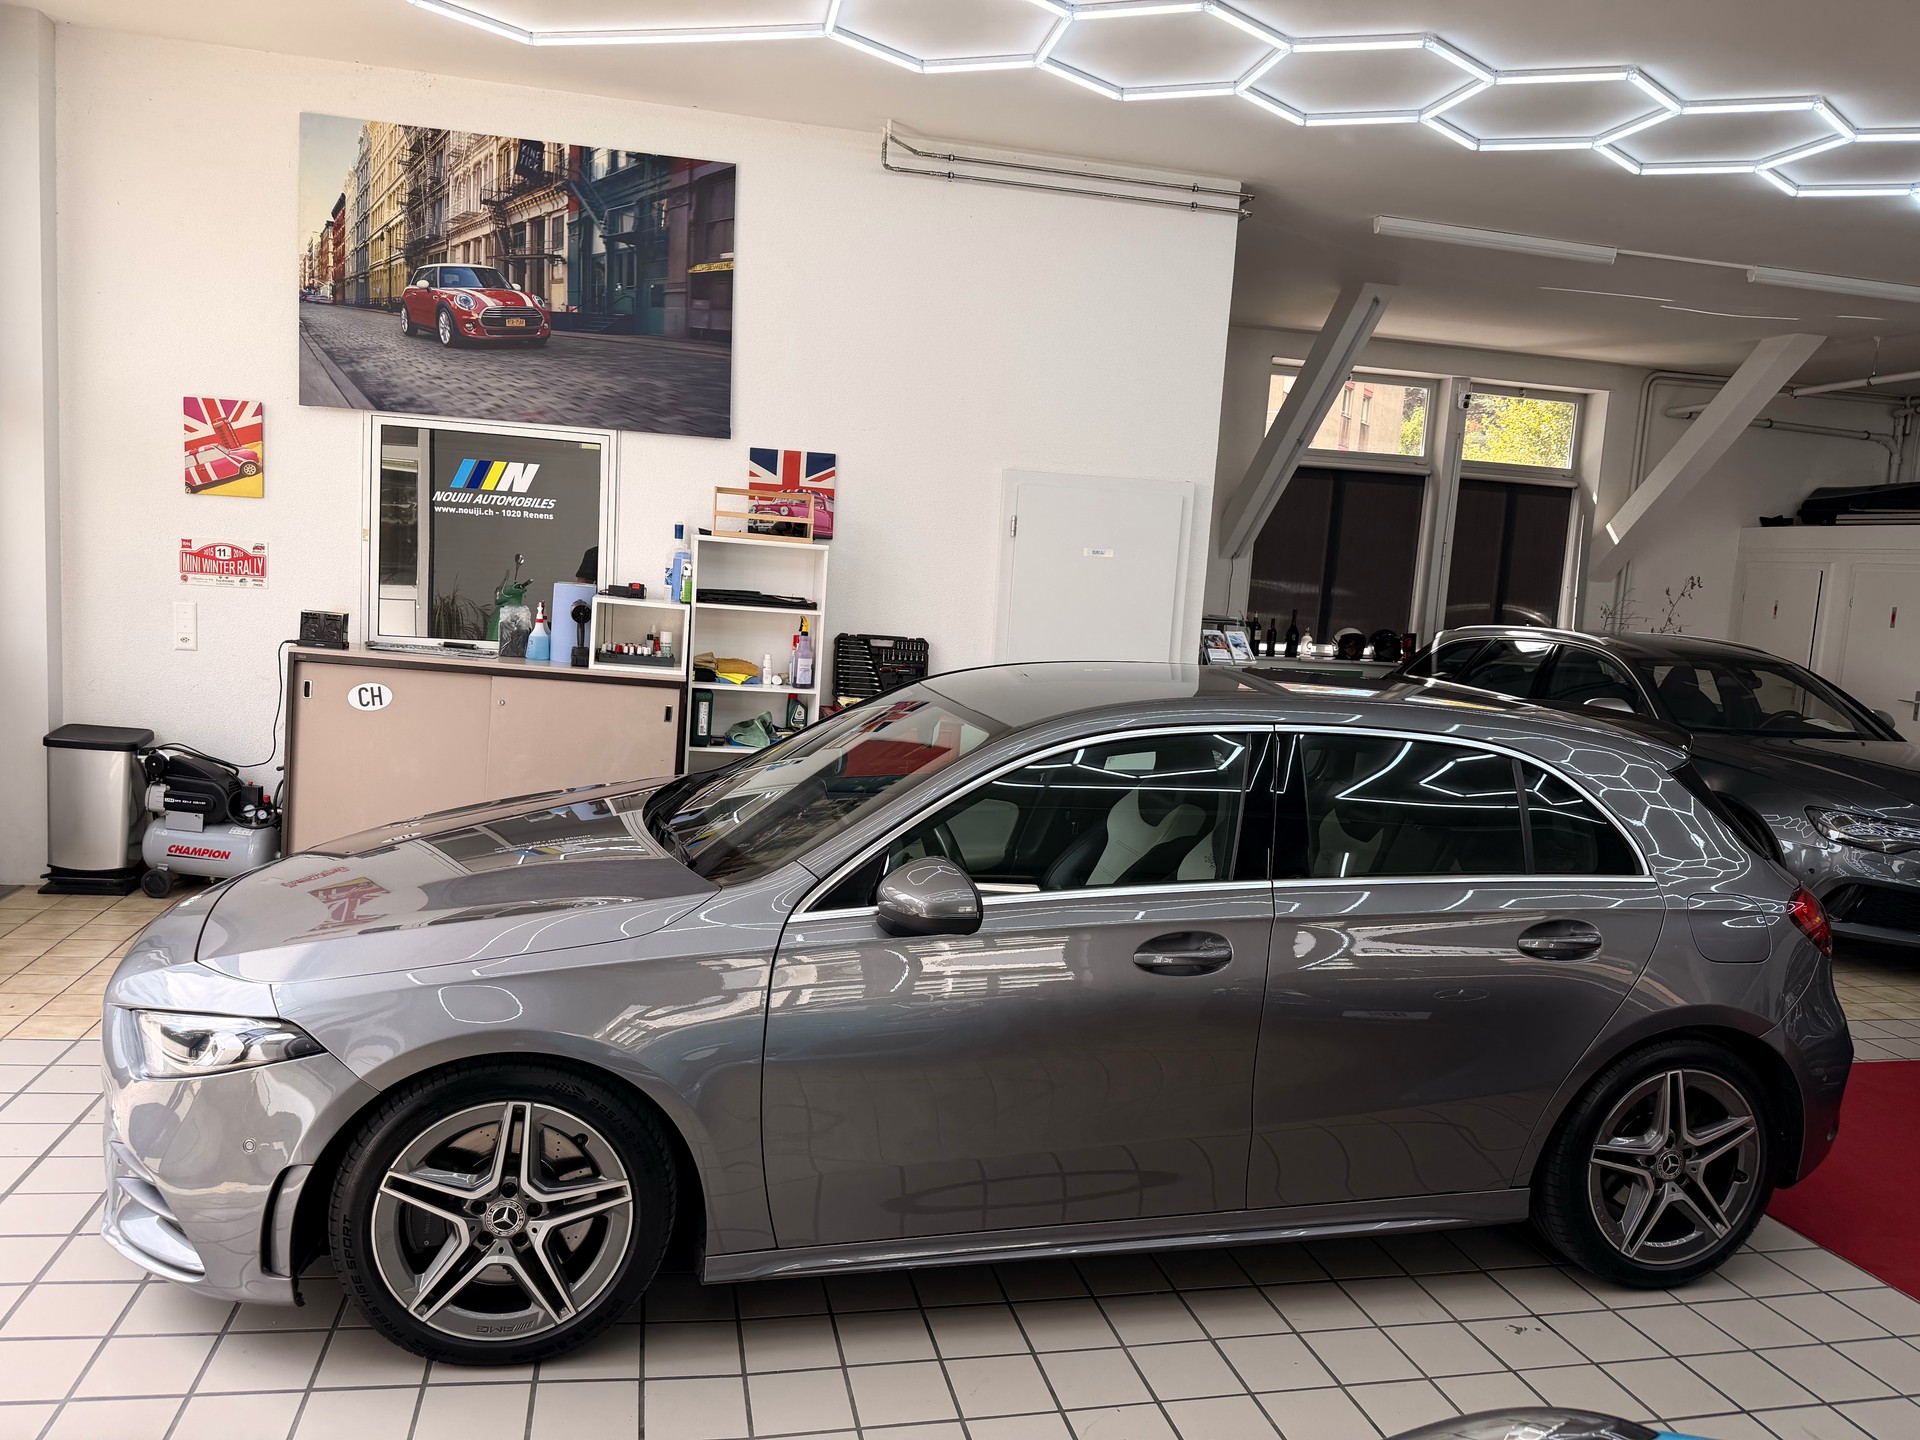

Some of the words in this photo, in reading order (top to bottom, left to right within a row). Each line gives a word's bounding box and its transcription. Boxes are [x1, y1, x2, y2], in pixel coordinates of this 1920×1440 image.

[432, 491, 474, 504] NOUIJI
[473, 494, 556, 509] AUTOMOBILES
[434, 506, 494, 516] www.nouiji.ch
[501, 509, 521, 518] 1020
[523, 511, 554, 520] Renens
[217, 548, 226, 557] 11
[182, 552, 201, 572] MINI
[202, 557, 236, 574] WINTER
[237, 557, 264, 576] RALLY
[358, 686, 383, 707] CH
[167, 844, 231, 860] CHAMPION
[342, 1215, 357, 1270] SPORT
[351, 1274, 405, 1339] PRESTIGE
